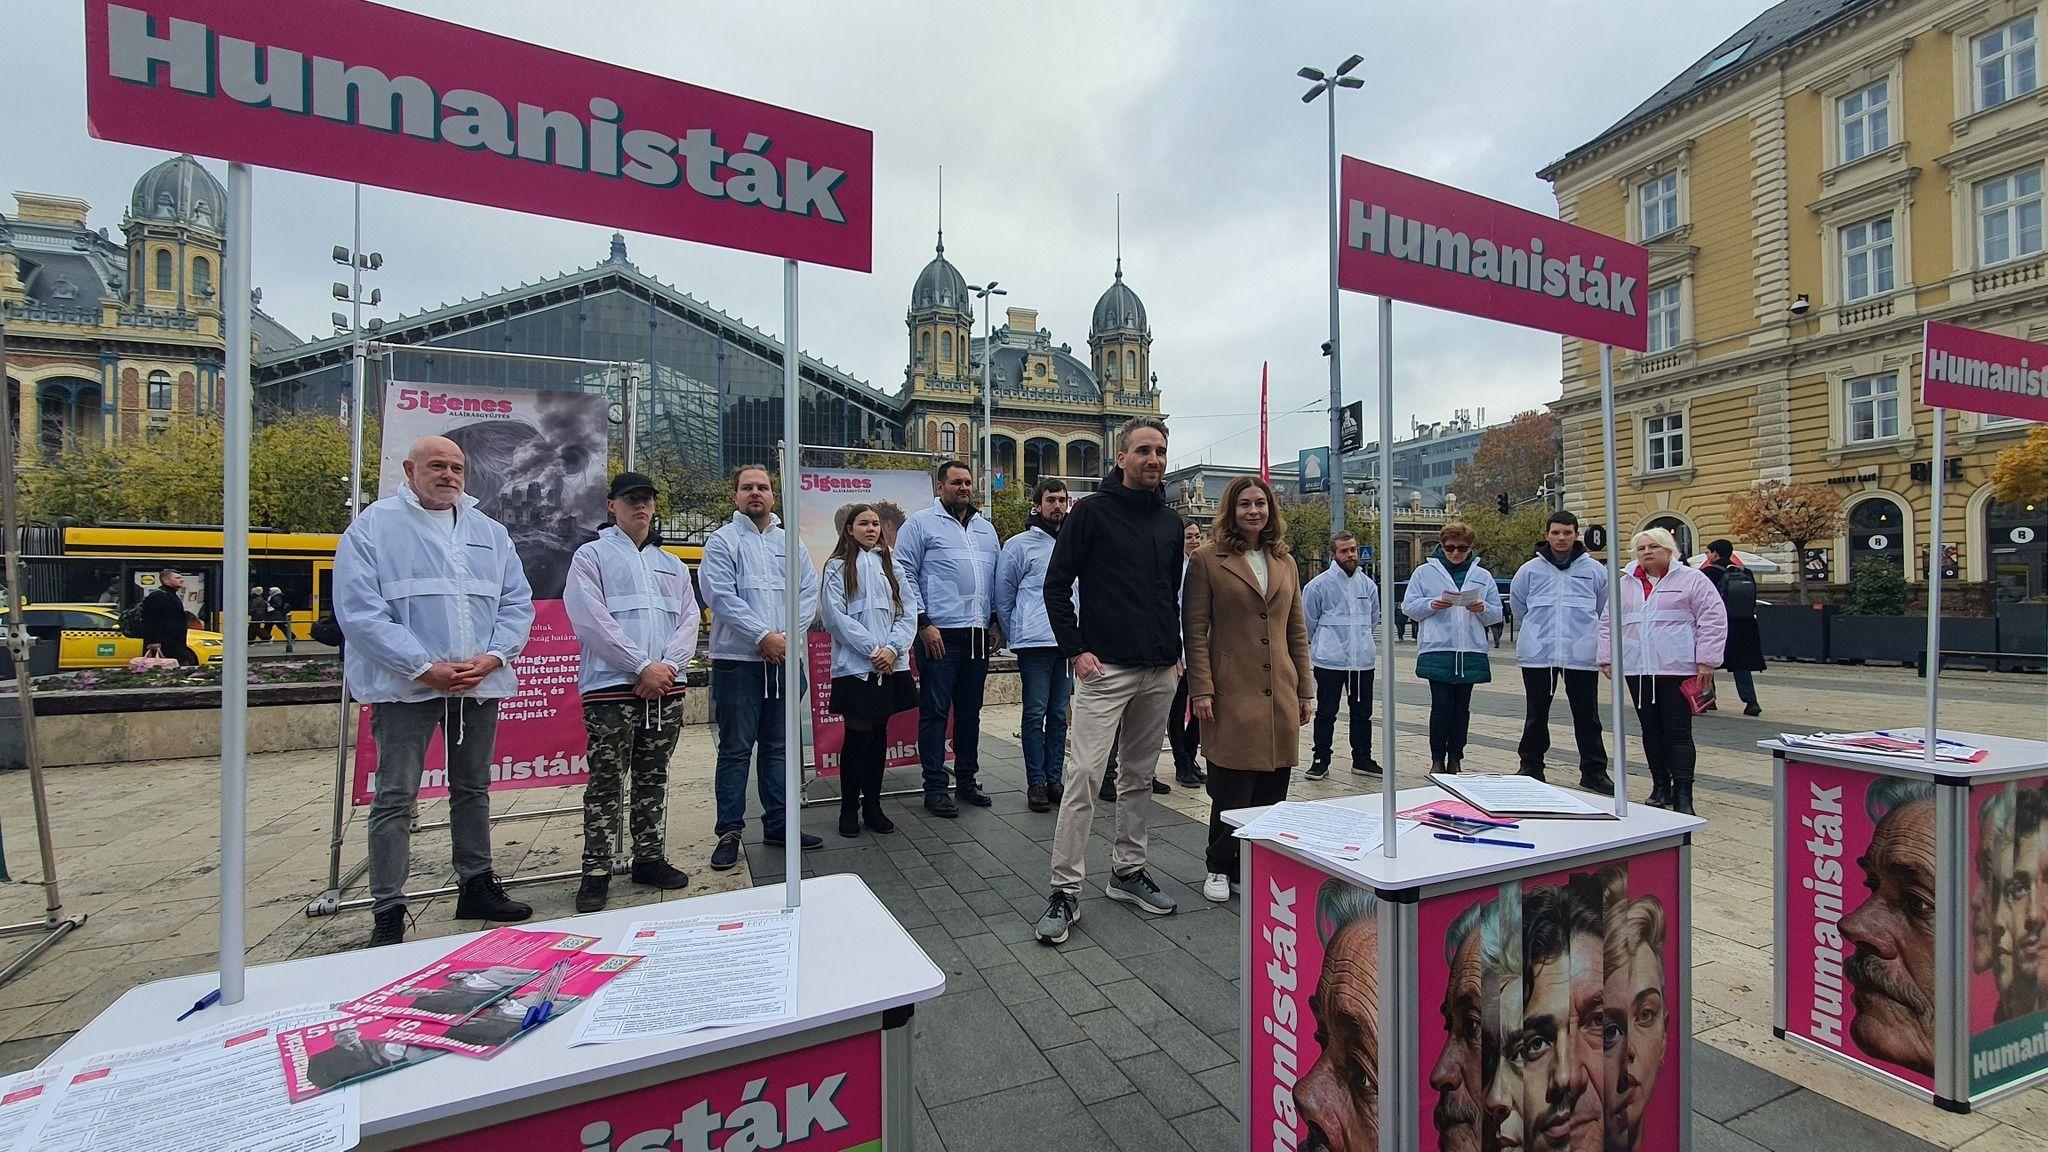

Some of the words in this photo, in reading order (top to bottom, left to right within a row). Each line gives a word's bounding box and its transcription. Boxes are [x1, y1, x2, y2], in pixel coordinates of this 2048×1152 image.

[108, 3, 848, 225] Humanisták
[1348, 199, 1637, 318] Humanisták
[550, 686, 565, 695] és
[1801, 781, 1844, 1047] Humanisták
